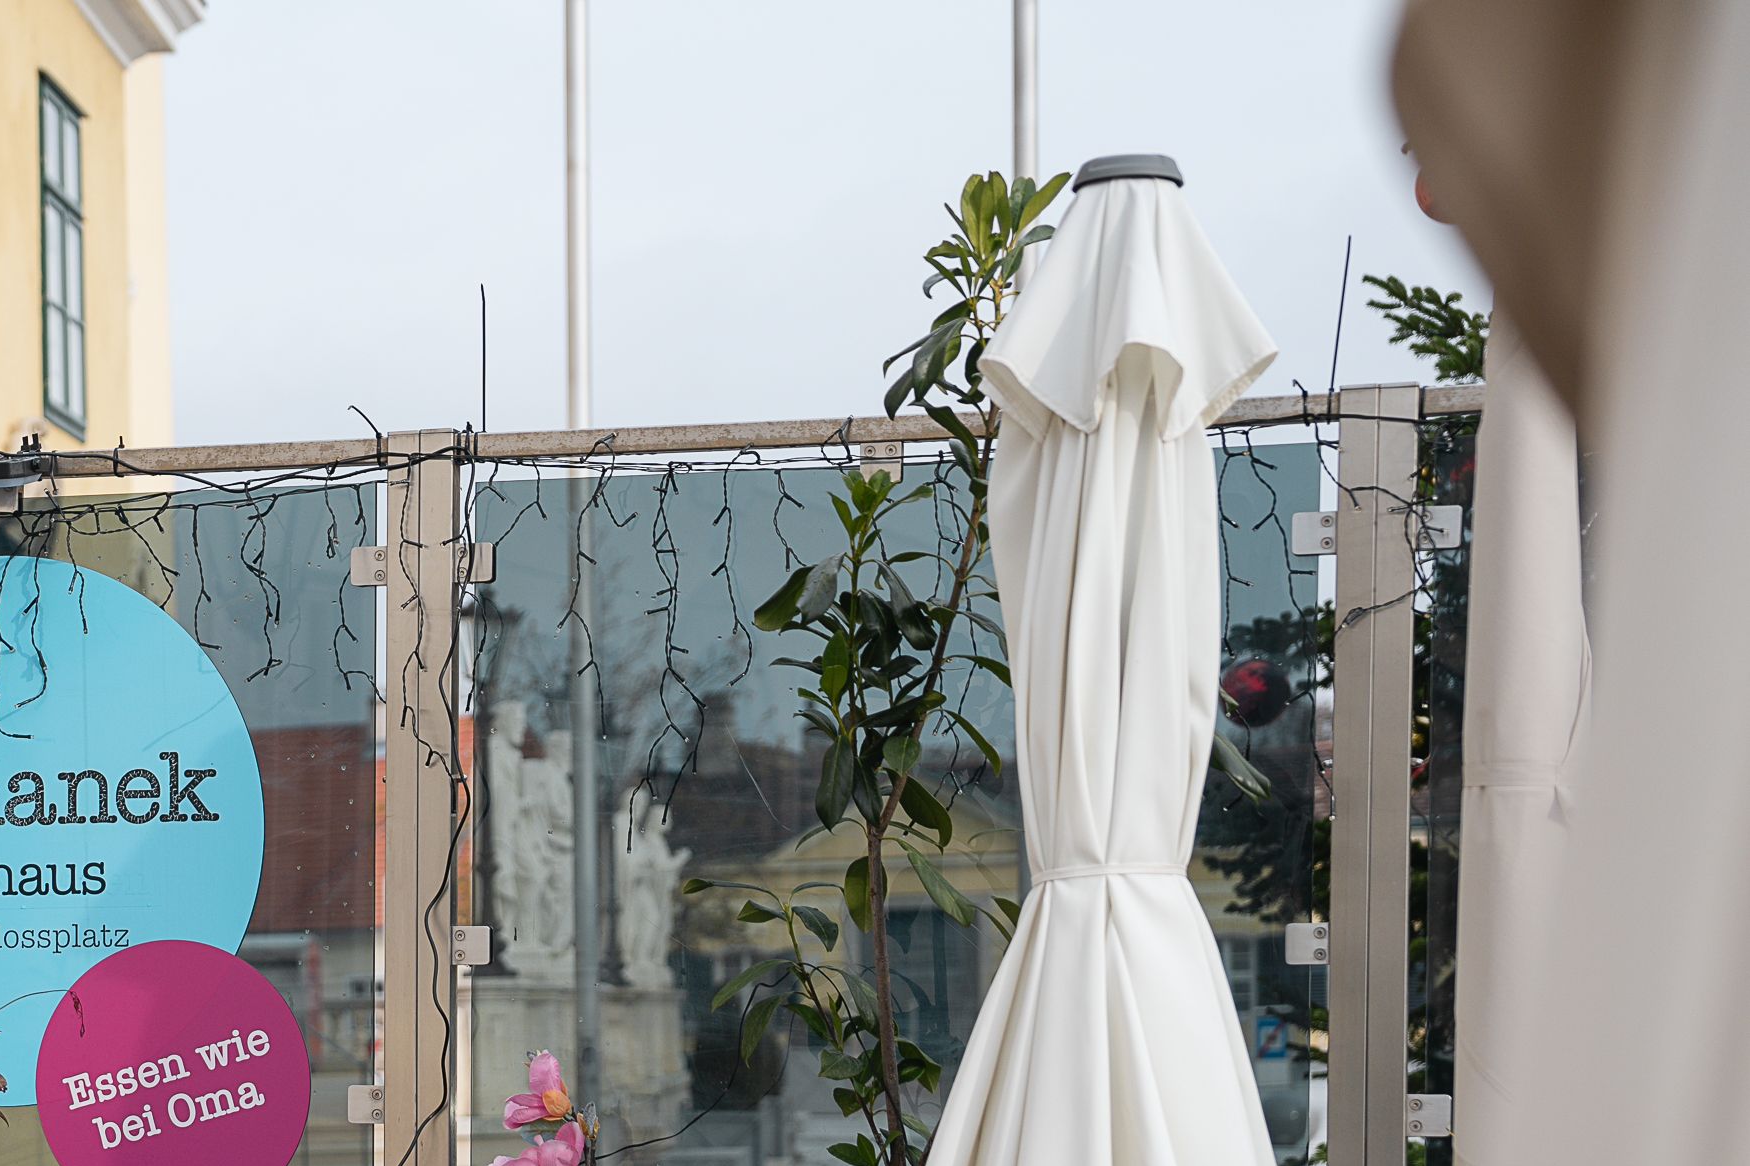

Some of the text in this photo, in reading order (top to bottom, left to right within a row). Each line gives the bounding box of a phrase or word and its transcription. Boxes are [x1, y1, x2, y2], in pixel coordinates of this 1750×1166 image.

[61, 1028, 271, 1111] Essen wie
[91, 1078, 266, 1150] bei Oma
